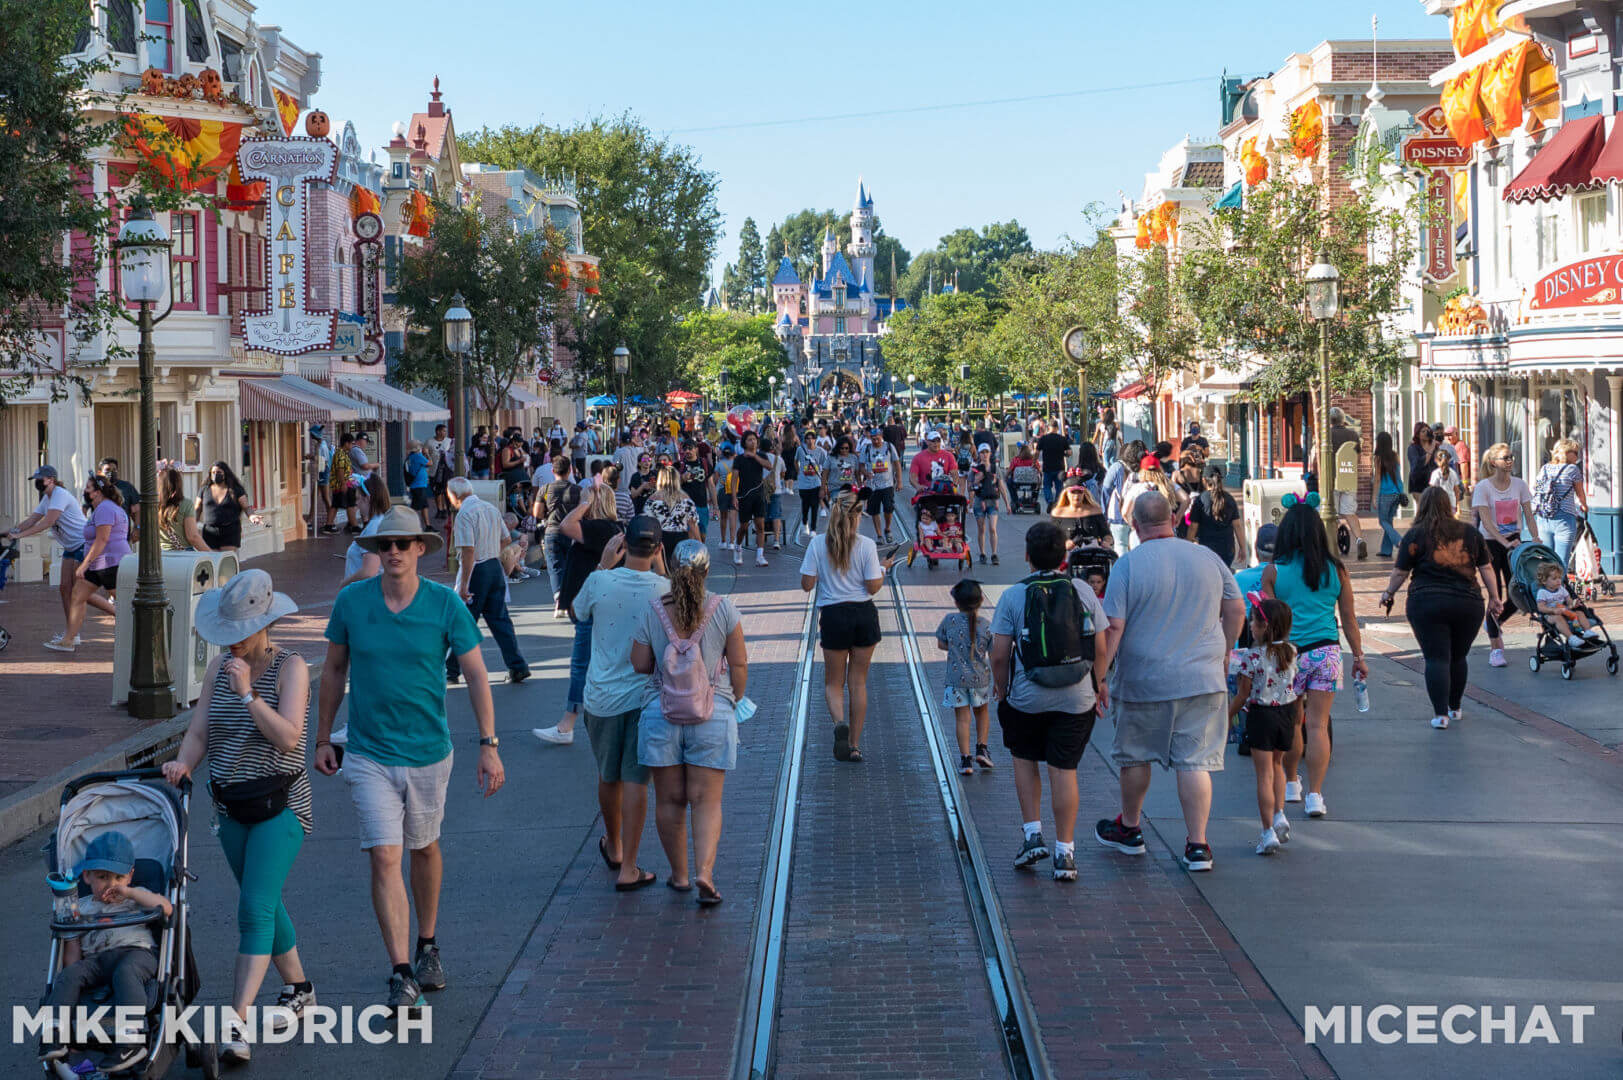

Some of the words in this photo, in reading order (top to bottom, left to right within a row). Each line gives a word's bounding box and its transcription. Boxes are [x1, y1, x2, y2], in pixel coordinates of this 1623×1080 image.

[246, 150, 325, 169] CARNATION
[1411, 147, 1465, 159] DISNEY
[276, 185, 297, 309] CAFÉ
[1544, 260, 1610, 304] DISNEY
